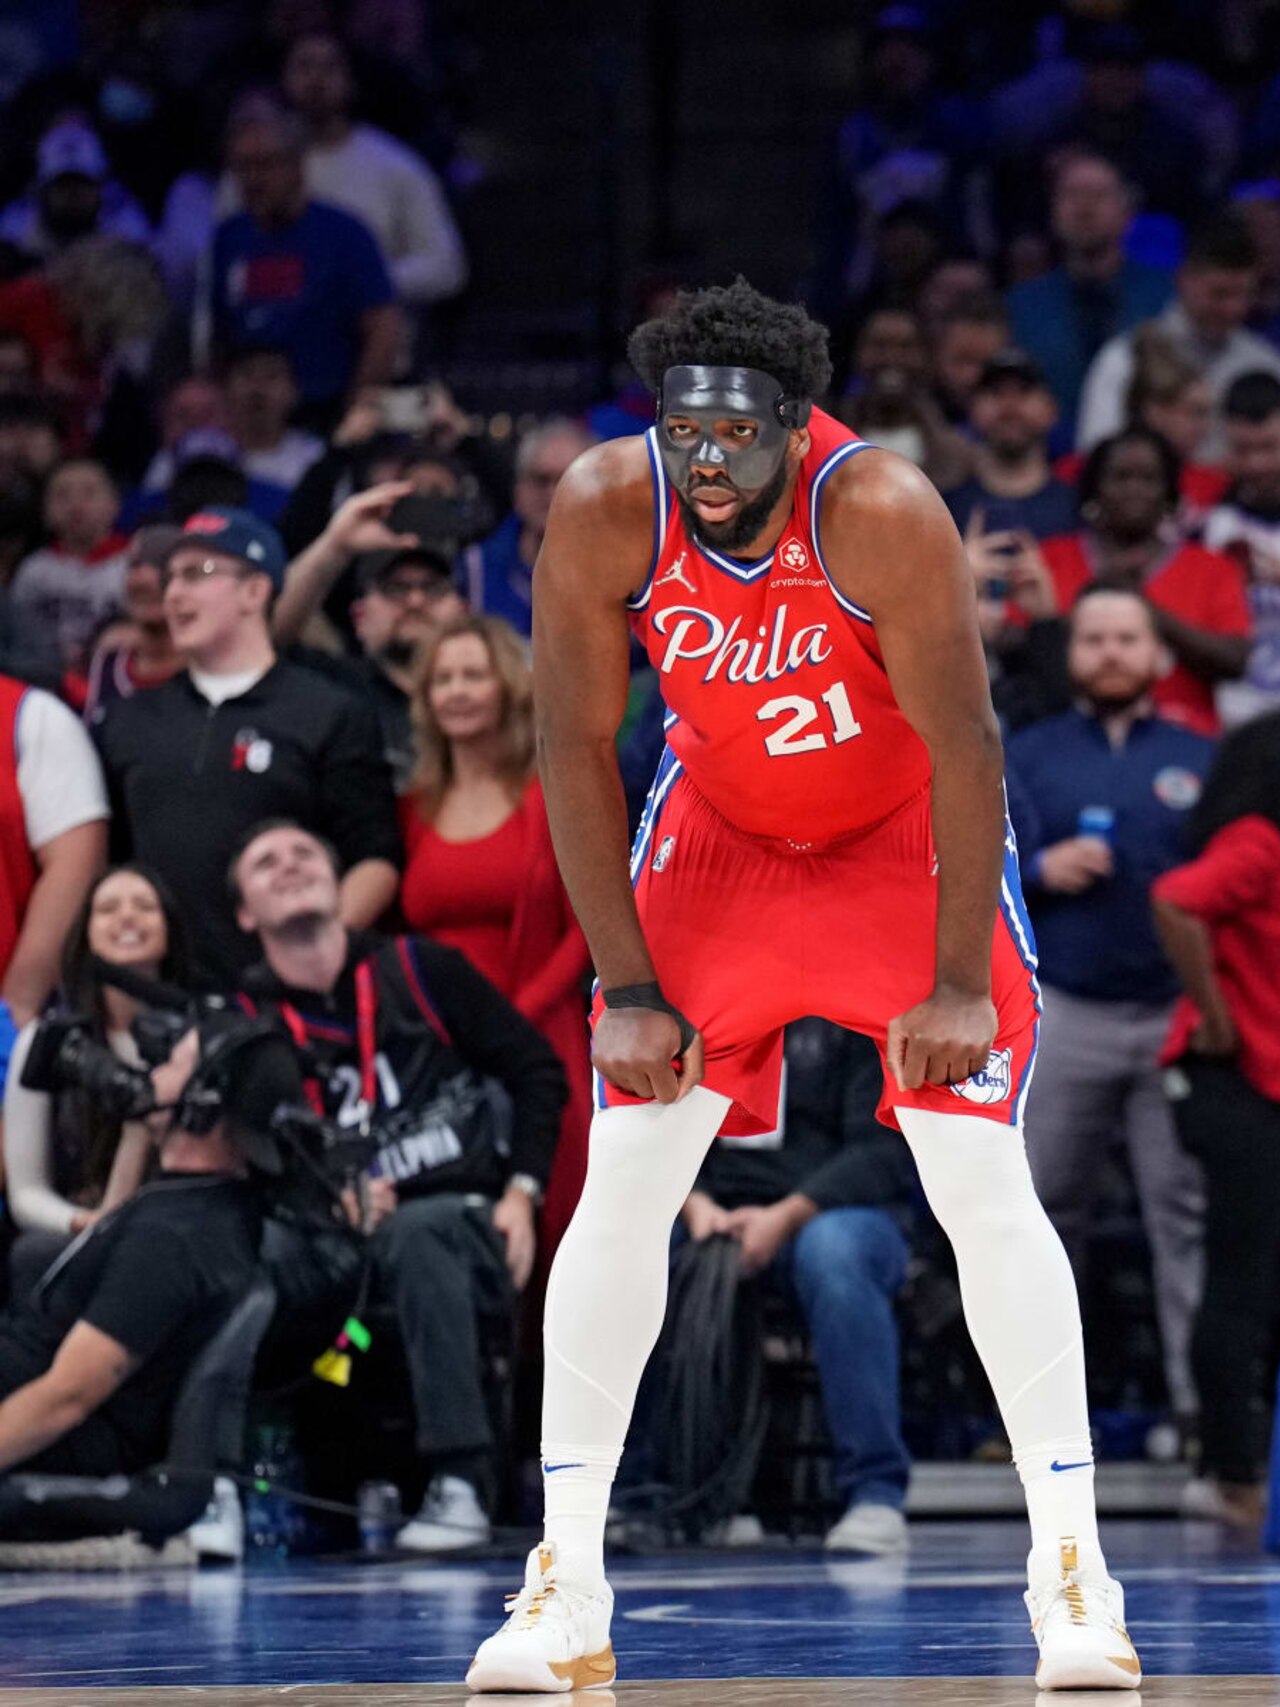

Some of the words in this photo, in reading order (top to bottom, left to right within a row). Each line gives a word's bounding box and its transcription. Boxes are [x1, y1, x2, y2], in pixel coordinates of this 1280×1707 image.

[770, 577, 827, 588] crypto.com
[653, 604, 833, 685] Phila
[756, 681, 862, 756] 21
